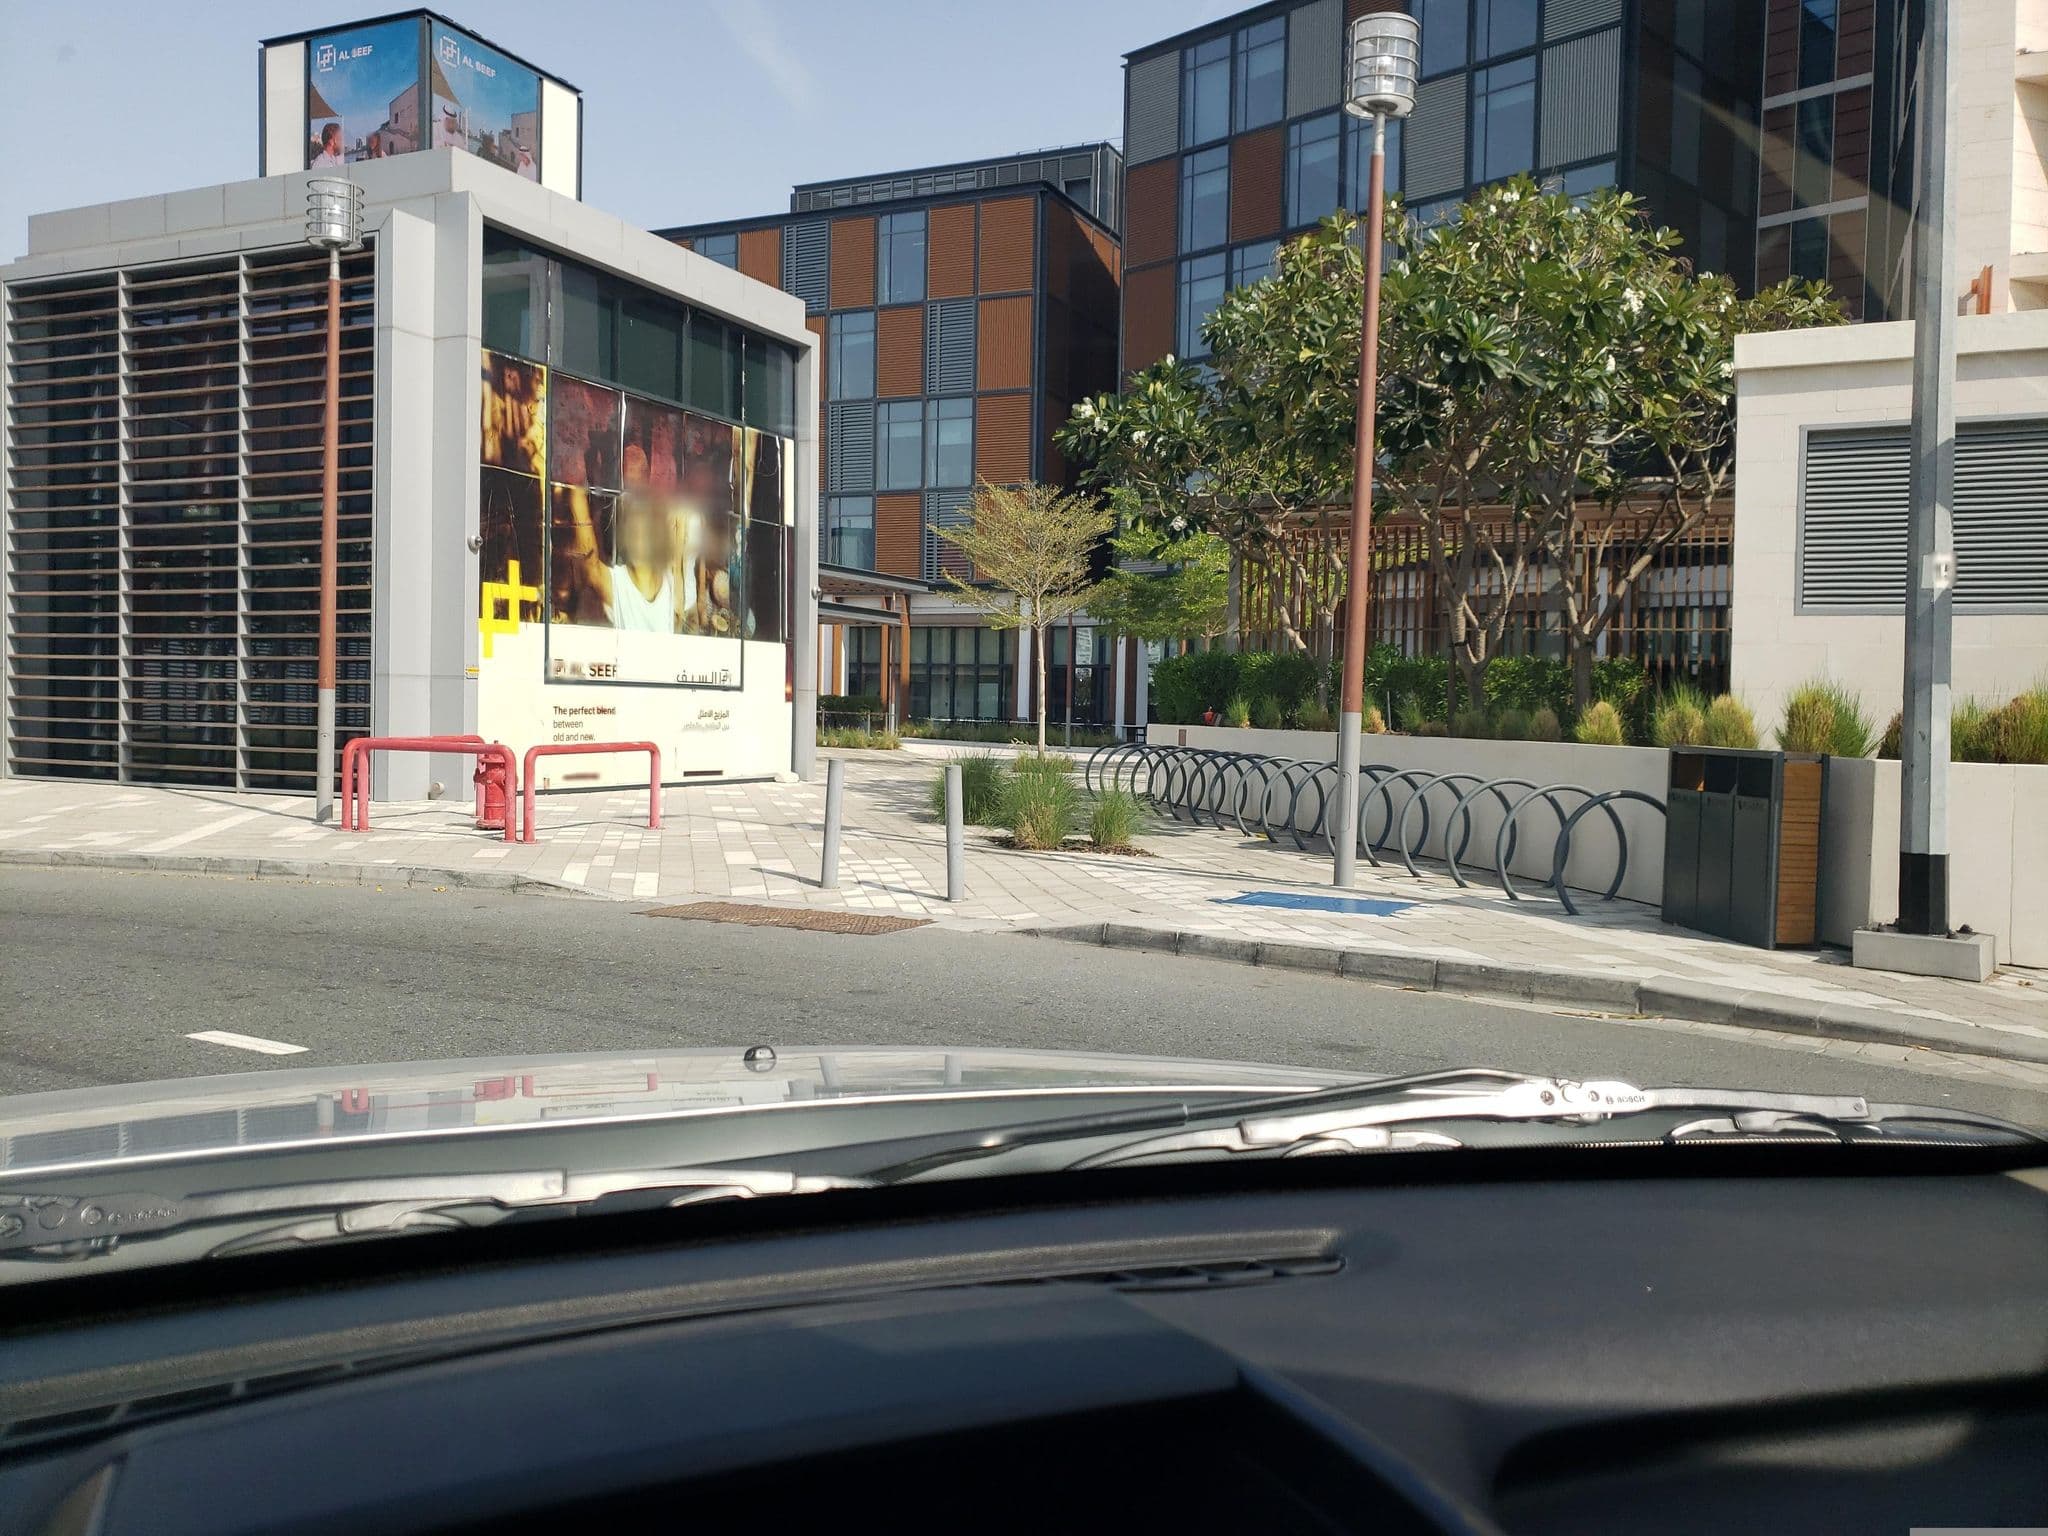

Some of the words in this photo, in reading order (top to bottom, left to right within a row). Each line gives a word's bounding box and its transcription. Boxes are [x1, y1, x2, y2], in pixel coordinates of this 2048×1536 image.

[339, 50, 350, 61] AL
[462, 56, 474, 68] AL
[553, 706, 567, 715] The
[569, 706, 595, 717] perfect
[596, 705, 616, 715] blend
[553, 720, 583, 728] between
[553, 733, 564, 741] old
[566, 733, 579, 741] and
